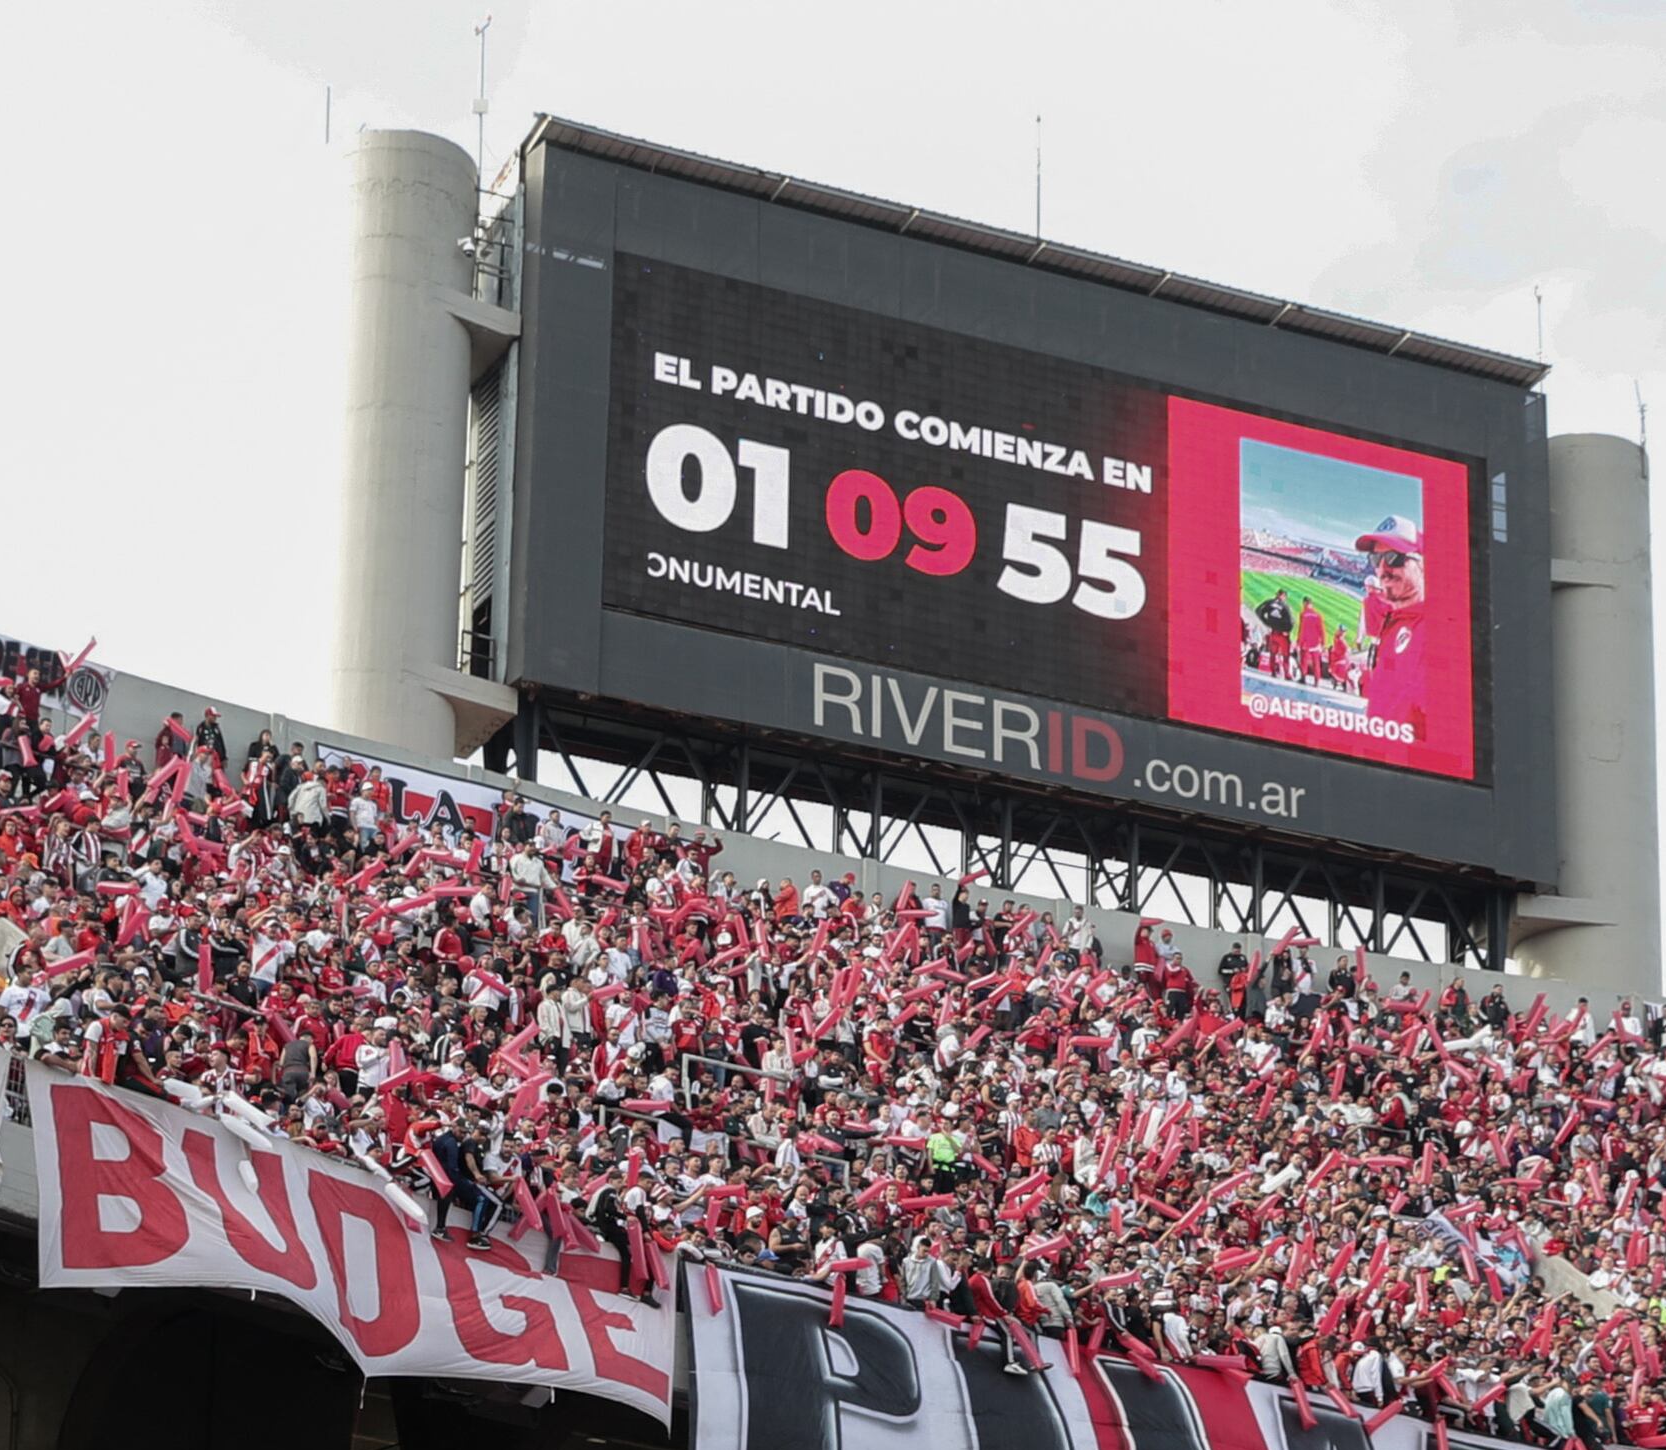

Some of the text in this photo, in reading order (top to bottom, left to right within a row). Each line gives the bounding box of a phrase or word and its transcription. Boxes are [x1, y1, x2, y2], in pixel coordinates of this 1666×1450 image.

[653, 351, 1153, 494] EL PARTIDO COMIENZA EN
[645, 423, 1148, 620] 01 09 55
[1248, 693, 1416, 745] @ALFOBURGOS
[49, 1083, 672, 1402] BUDGE
